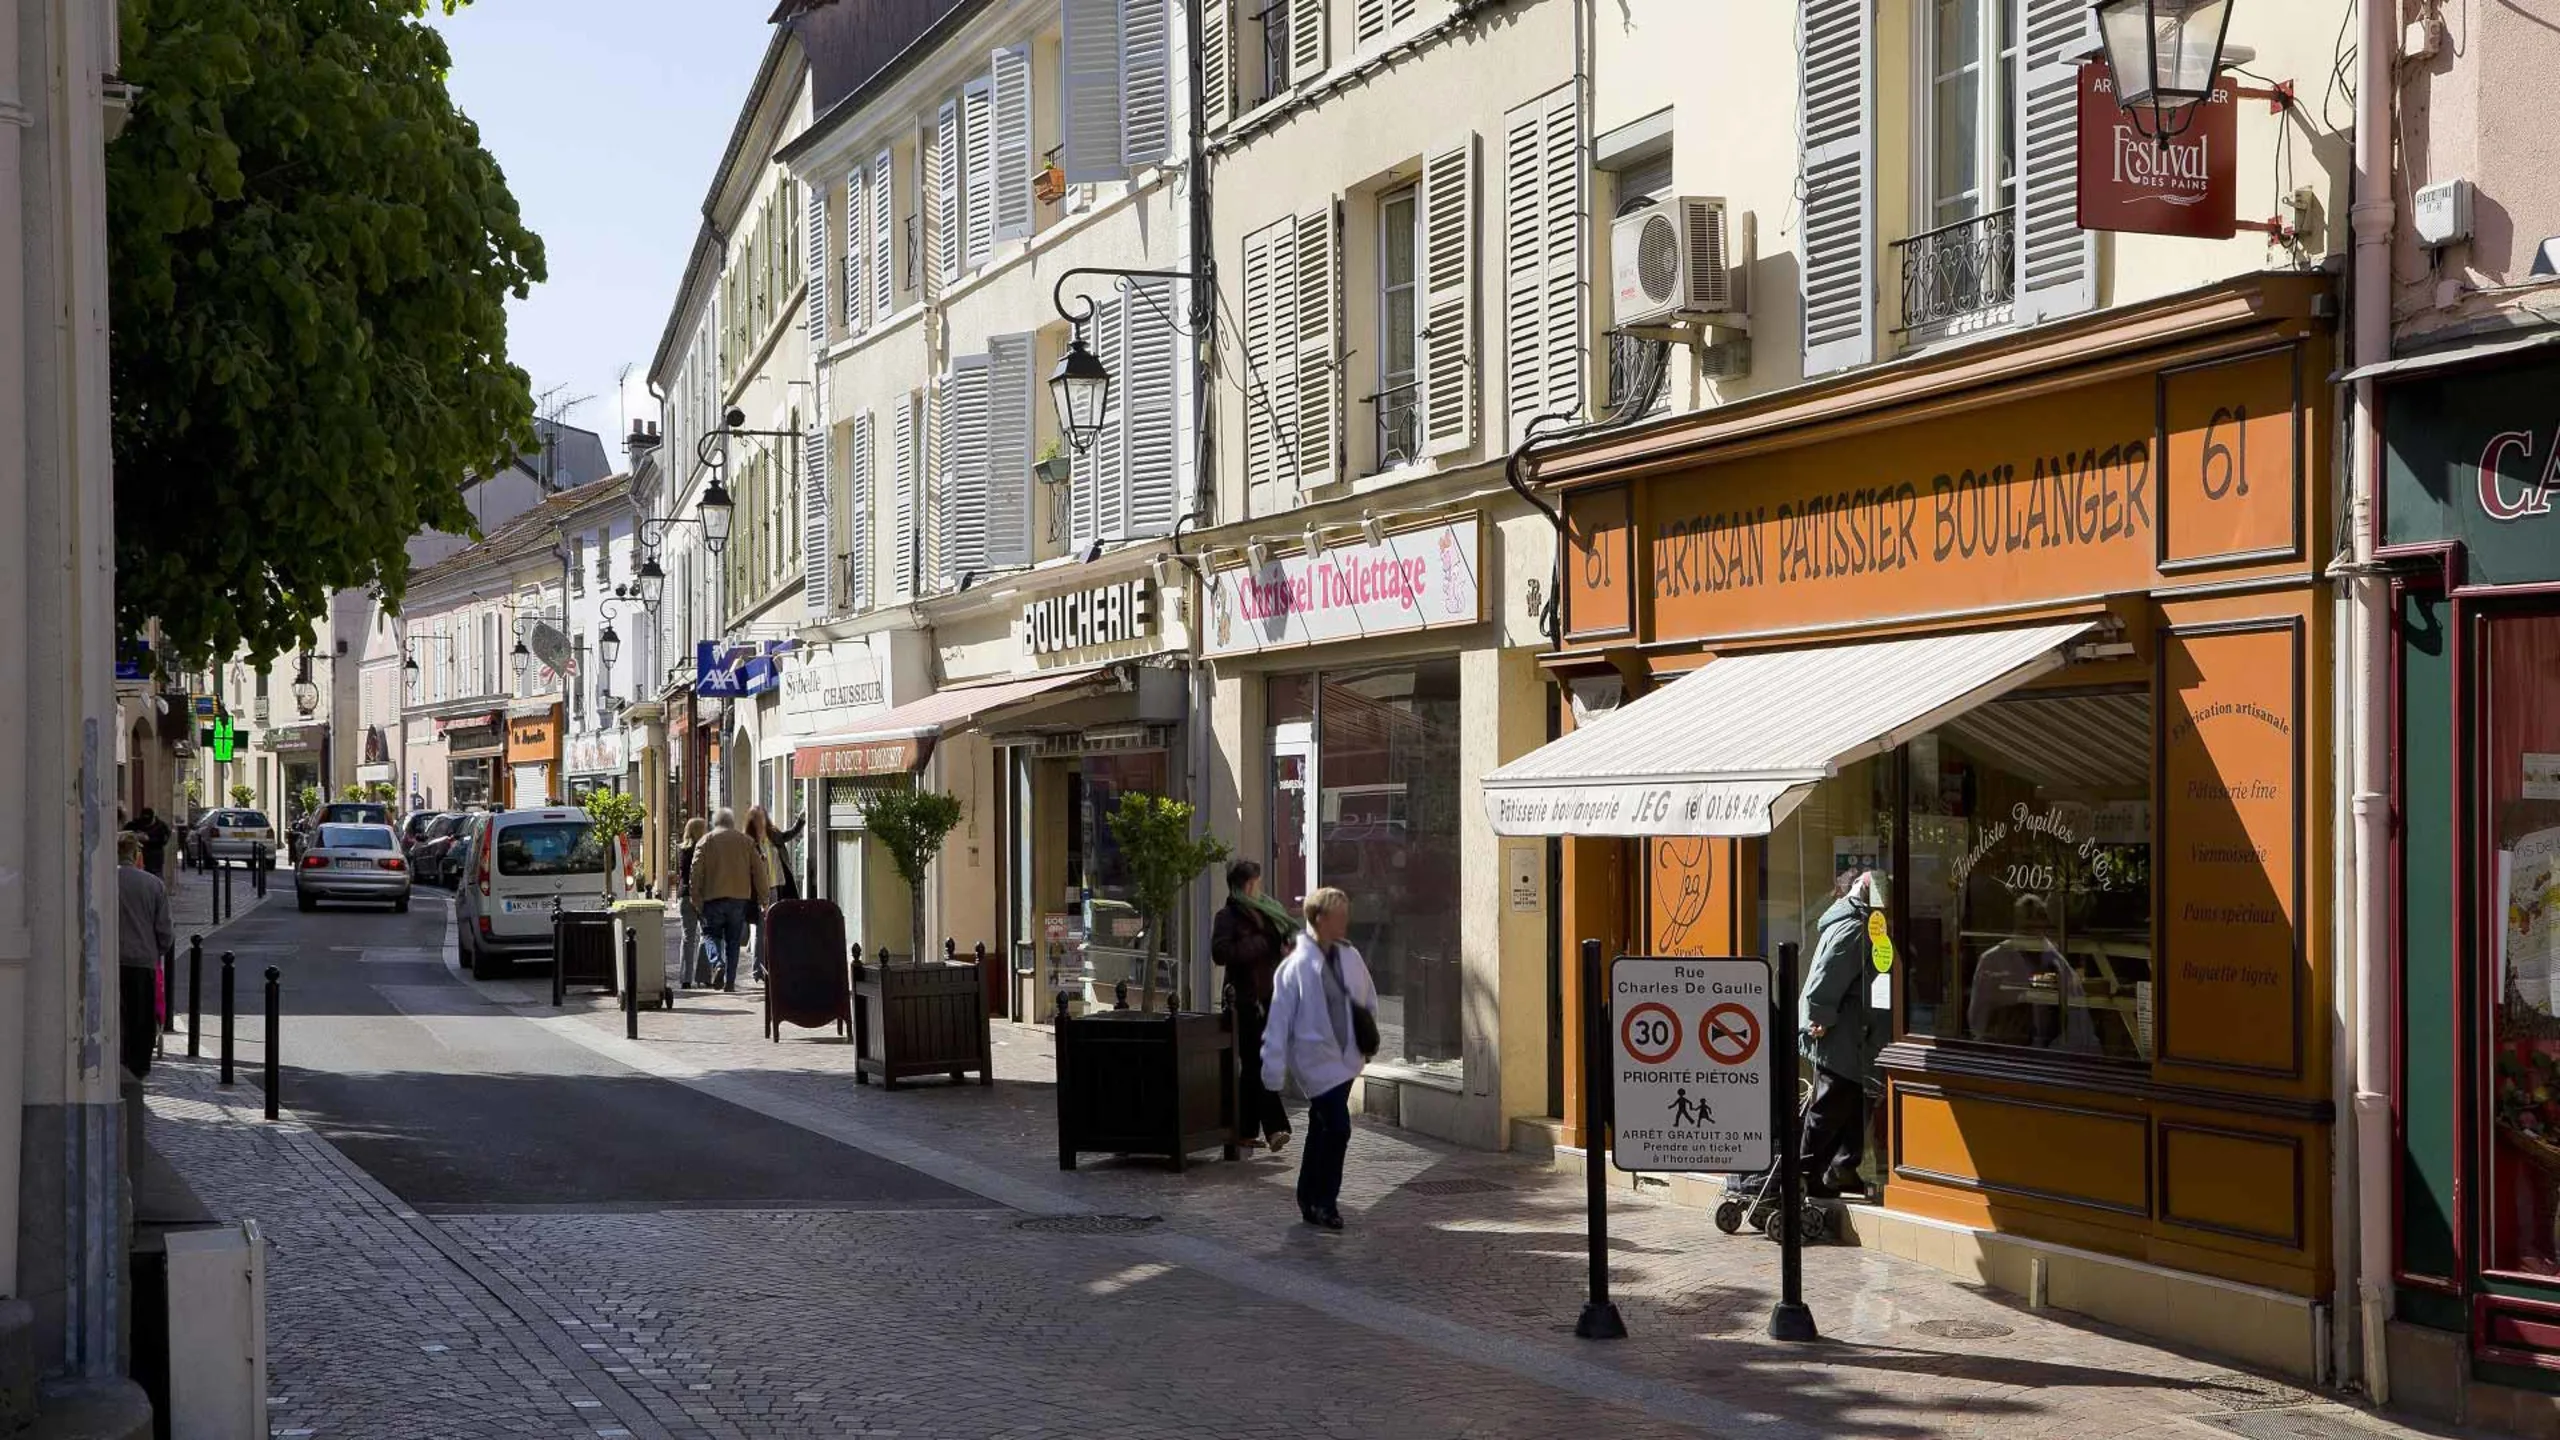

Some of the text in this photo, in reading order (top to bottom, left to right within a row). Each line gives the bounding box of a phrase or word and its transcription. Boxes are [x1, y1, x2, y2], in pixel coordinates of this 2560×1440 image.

[2112, 124, 2209, 184] Festival
[2142, 176, 2208, 191] DES PAINS
[2201, 403, 2250, 501] 61
[1652, 504, 1766, 598] ARTISAN
[1777, 481, 1918, 583] PATISSIER
[1932, 439, 2151, 564] BOULANGER
[1585, 522, 1612, 590] 61
[1238, 554, 1427, 621] Christel Toilettage
[1023, 578, 1147, 656] BOUCHERIE
[696, 668, 741, 691] AXA
[823, 681, 884, 706] CHAUSSEUR
[2235, 701, 2290, 736] artisanale
[2250, 779, 2277, 801] fine
[1500, 797, 1548, 824] Pâtisserie
[1632, 790, 1672, 823] JEG
[1951, 821, 2008, 887] Finaliste
[2012, 801, 2075, 845] Papilles
[2004, 864, 2053, 890] 2005
[1675, 966, 1705, 979] Rue
[1618, 981, 1763, 995] Charles De Gaulle
[1634, 1020, 1669, 1046] 30
[1623, 1069, 1760, 1085] PRIORITÉ PIÉTONS
[1622, 1129, 1763, 1142] ARRÊT GRATUIT 30 MN
[1643, 1142, 1742, 1153] Prendre un ticket
[1653, 1154, 1734, 1165] à l'horodateur
